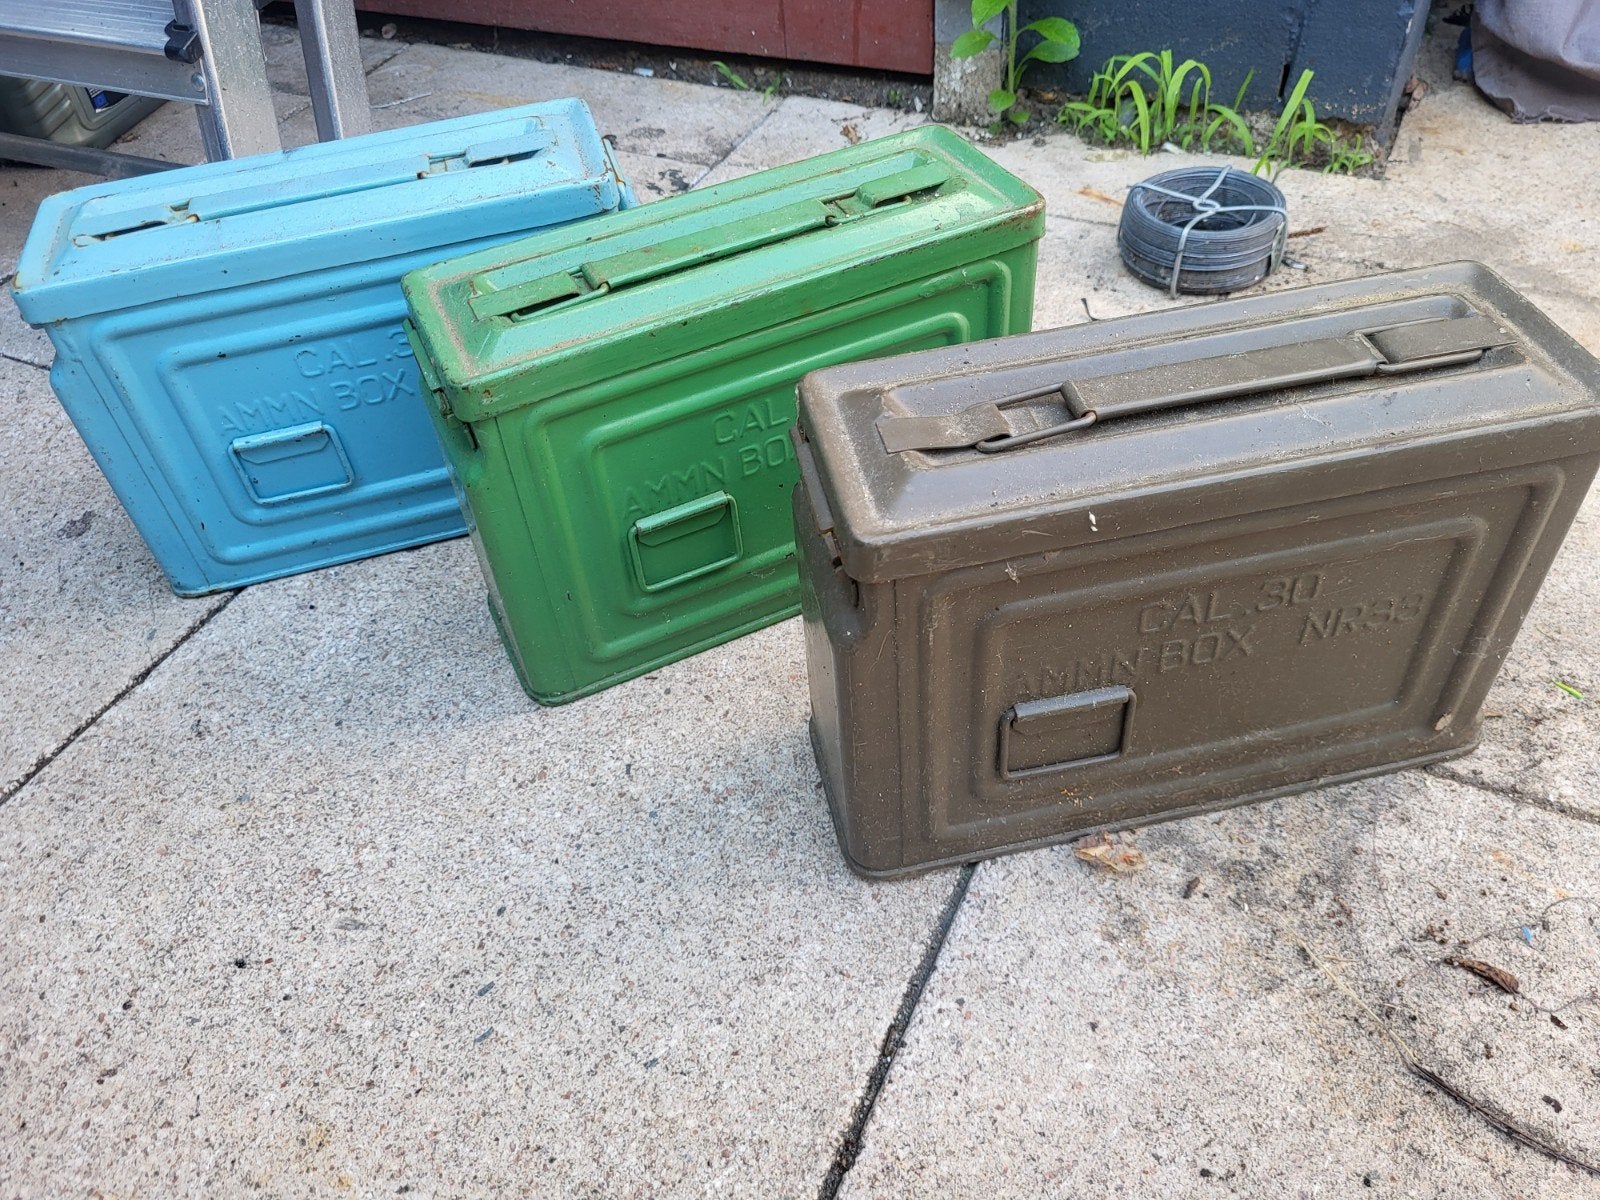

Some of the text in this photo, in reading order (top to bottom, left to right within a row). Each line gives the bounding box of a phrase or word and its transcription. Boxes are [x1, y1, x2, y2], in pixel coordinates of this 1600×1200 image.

[219, 368, 415, 436] AMMN BOX
[623, 433, 796, 518] AMMN BO
[1159, 625, 1256, 673] BOX
